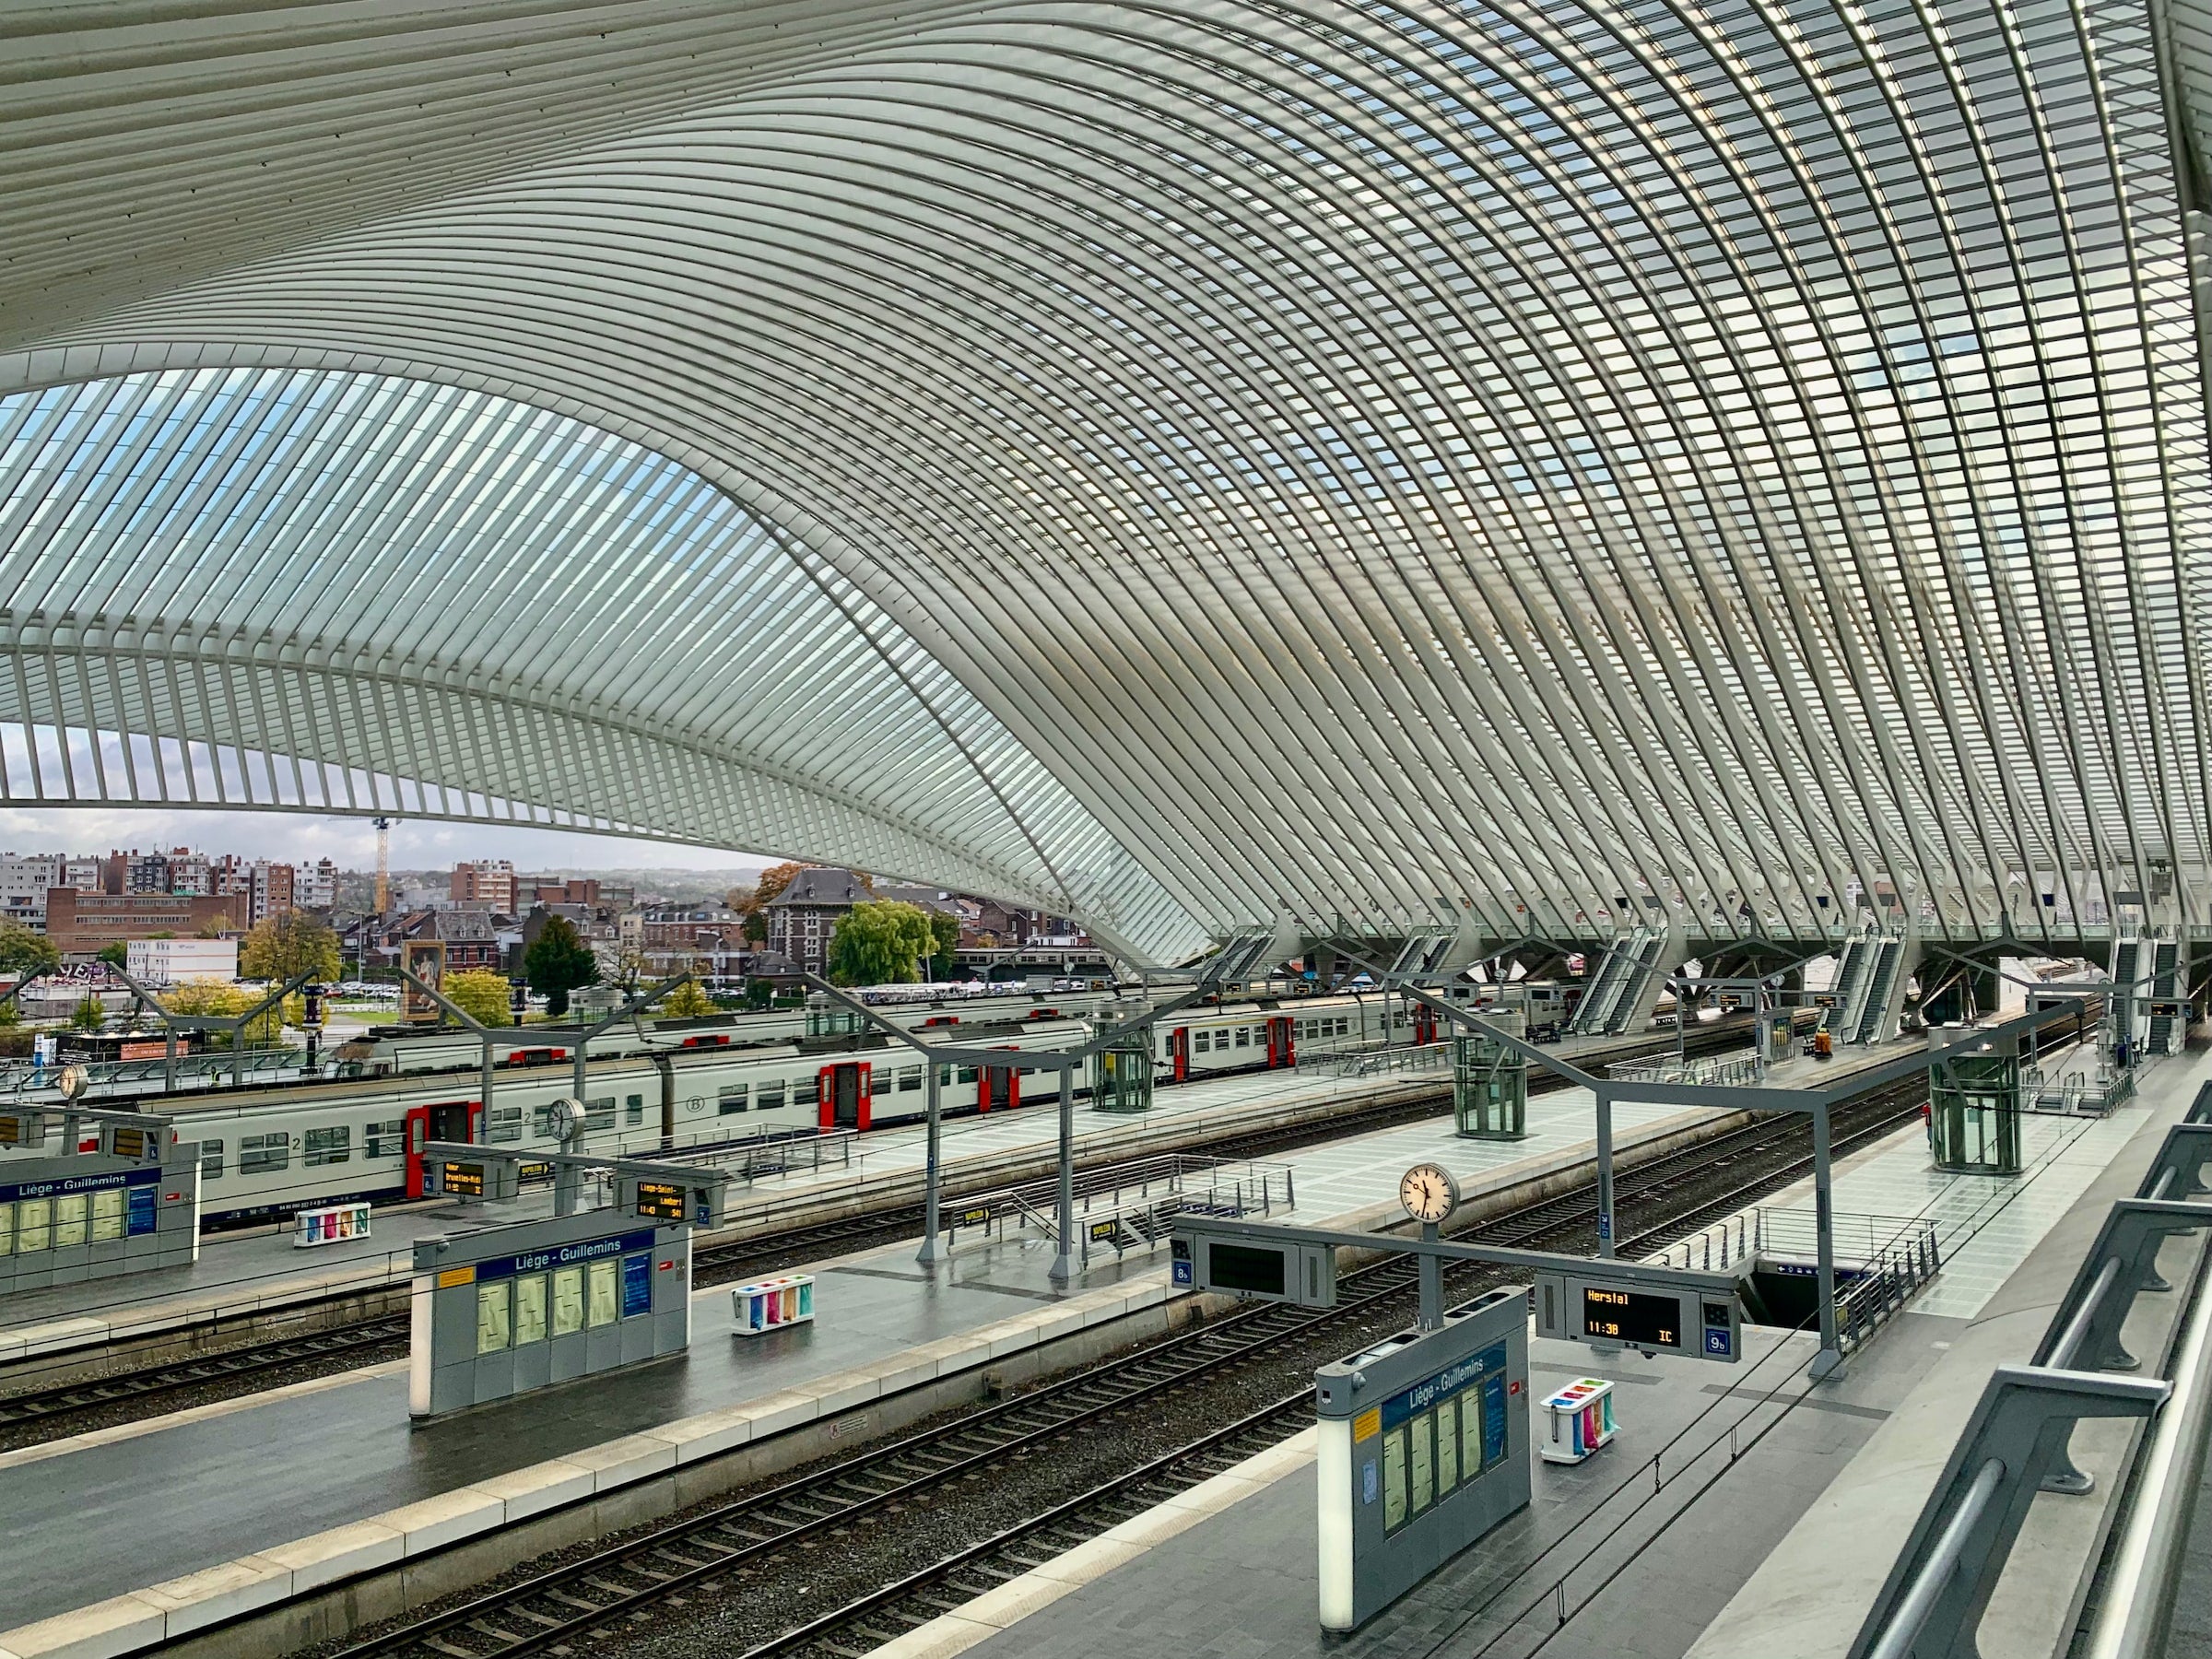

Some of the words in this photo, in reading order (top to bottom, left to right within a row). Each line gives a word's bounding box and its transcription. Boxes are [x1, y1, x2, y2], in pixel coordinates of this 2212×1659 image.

[524, 1112, 531, 1123] 2
[292, 1137, 300, 1150] 2
[18, 1182, 53, 1196] Liège
[64, 1175, 126, 1190] Guillemins
[516, 1254, 549, 1270] Liège
[560, 1241, 621, 1262] Guillemins
[1178, 1268, 1188, 1279] 8b
[1587, 1290, 1629, 1305] Herstal
[1589, 1321, 1618, 1335] 11:38
[1659, 1330, 1672, 1343] IC
[1710, 1337, 1725, 1350] 9b
[1410, 1385, 1434, 1409] Liège
[1441, 1358, 1484, 1392] Guillemins
